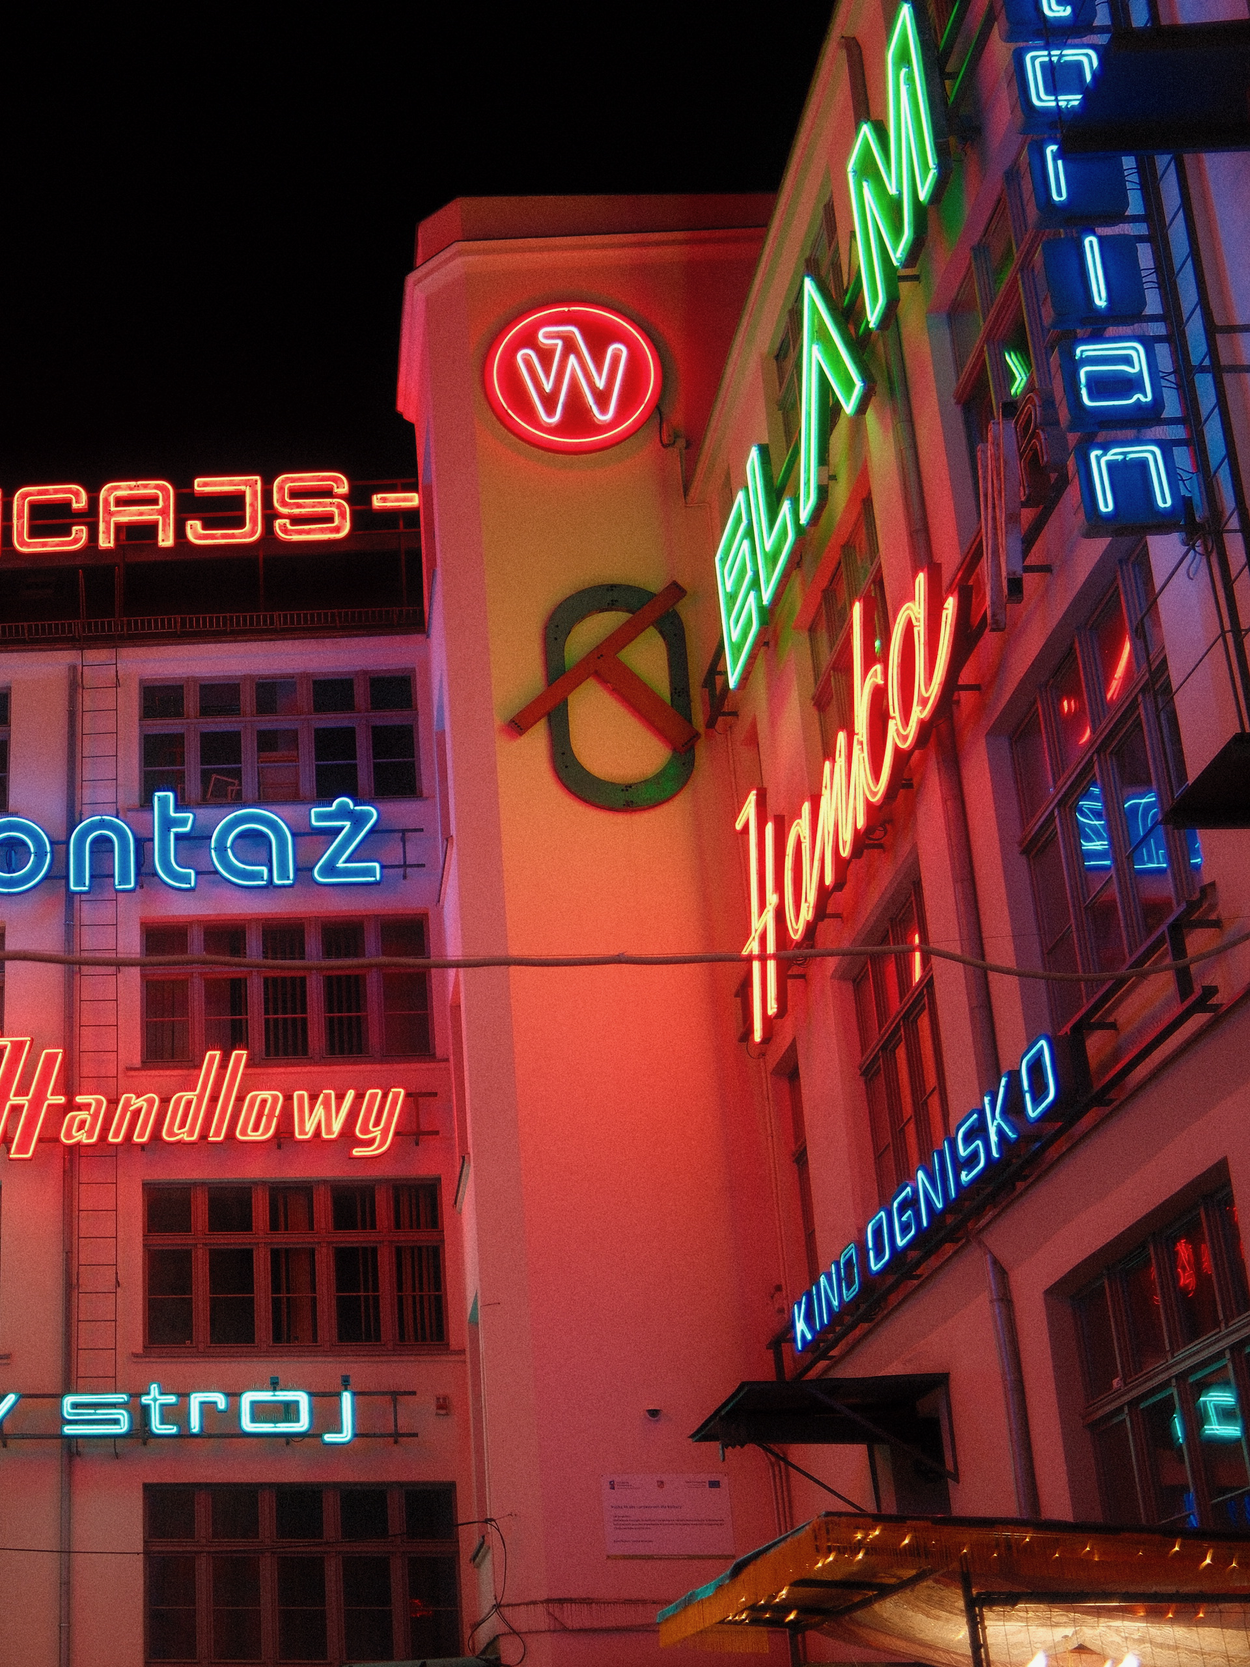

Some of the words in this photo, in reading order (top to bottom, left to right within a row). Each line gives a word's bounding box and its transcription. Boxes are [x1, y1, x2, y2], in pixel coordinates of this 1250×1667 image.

[734, 570, 960, 1044] Hanka
[791, 1241, 860, 1352] KINO
[865, 1034, 1057, 1275] OGNISKO
